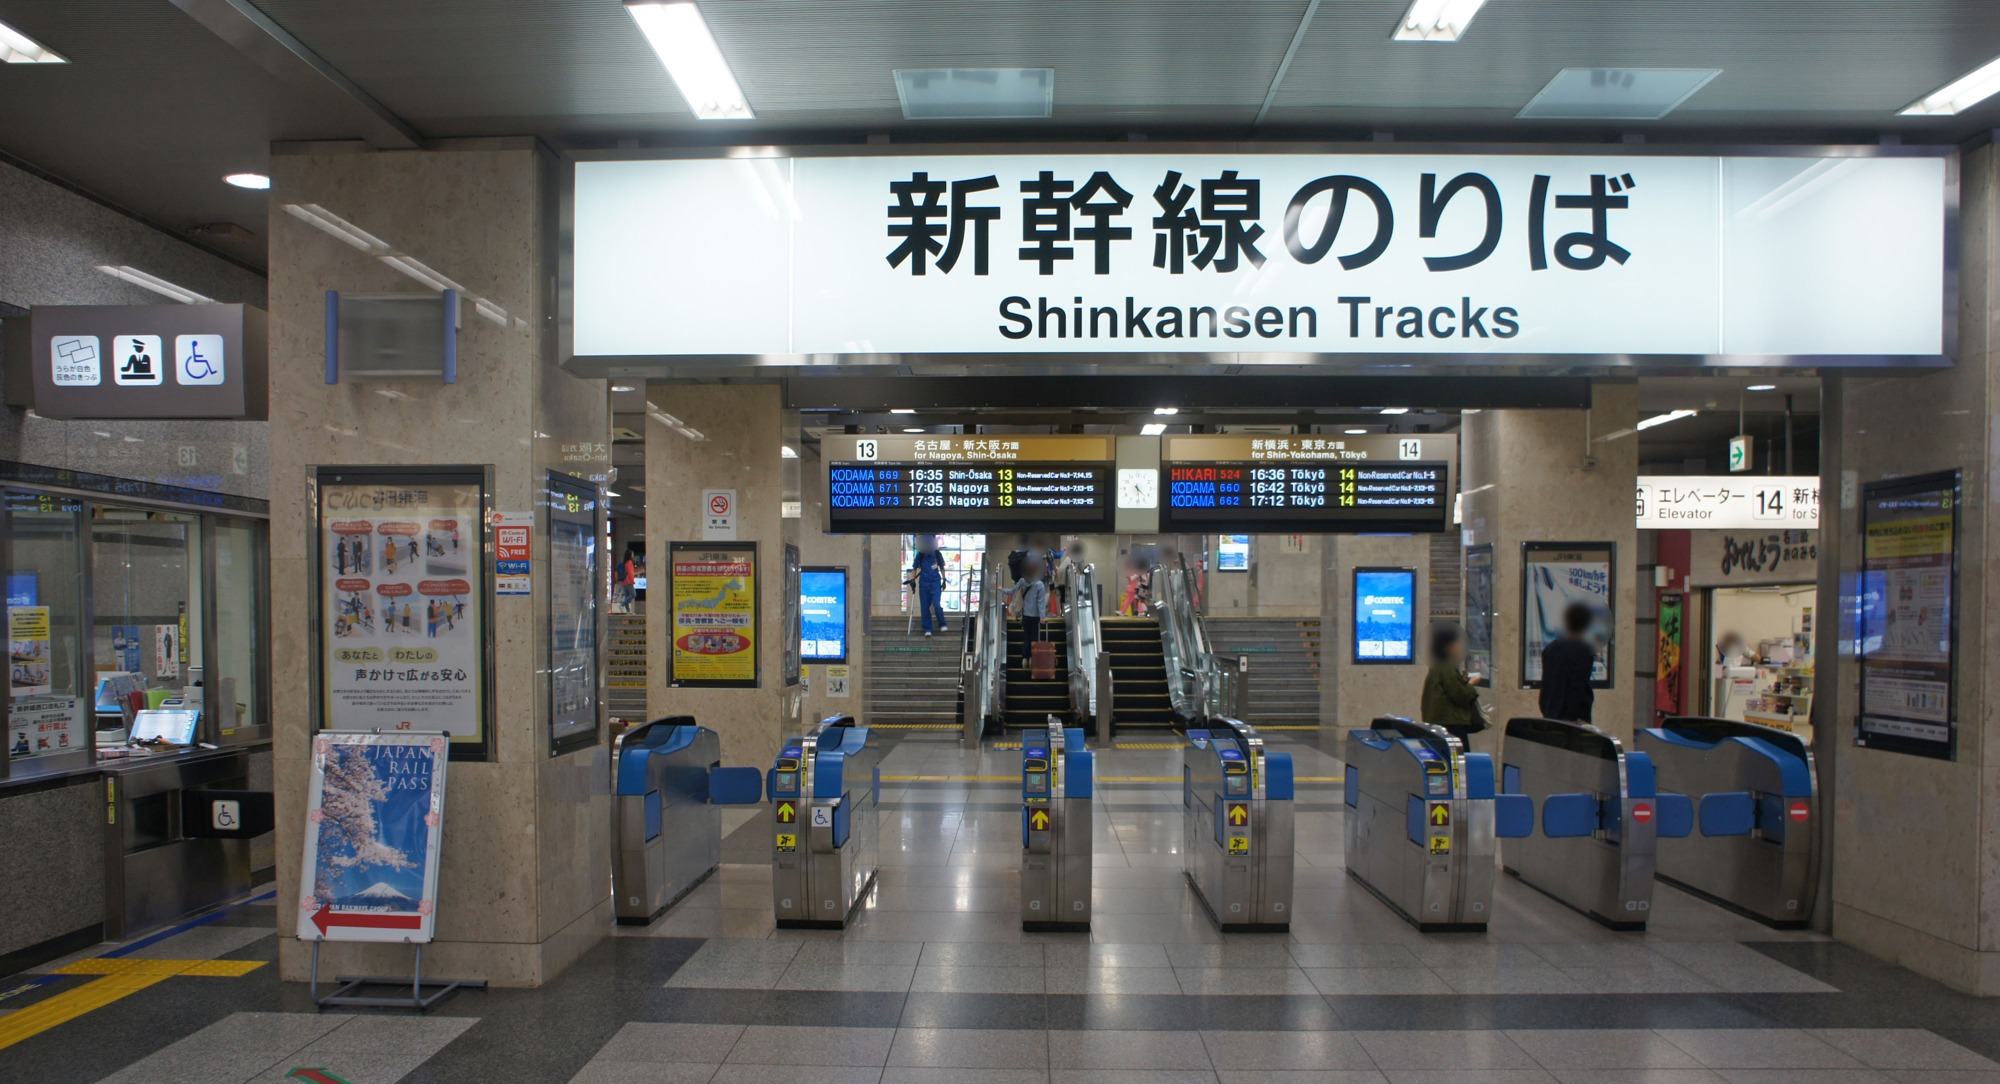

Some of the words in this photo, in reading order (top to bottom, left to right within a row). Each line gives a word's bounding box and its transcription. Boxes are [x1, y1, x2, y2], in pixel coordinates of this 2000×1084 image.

[886, 170, 1636, 276] 新幹線のりば
[998, 296, 1317, 339] Shinkansen
[1337, 296, 1520, 339] Tracks
[858, 442, 875, 458] 13
[914, 452, 927, 460] for
[929, 452, 964, 461] Nagoya,
[966, 450, 1017, 460] Shin-Ōsaka
[1252, 450, 1264, 458] for
[1266, 450, 1338, 460] Shin-Yokohama,
[1340, 450, 1367, 460] Tōkyō
[1402, 442, 1418, 458] 14
[832, 470, 874, 480] KODAMA
[880, 471, 898, 480] 669
[909, 470, 943, 480] 16:35
[948, 469, 992, 480] Shin-Ōsaka
[998, 470, 1013, 480] 13
[1172, 468, 1217, 480] HIKARI
[1220, 470, 1240, 480] 524
[1250, 469, 1285, 480] 16:36
[1290, 469, 1325, 482] Tōkyō
[1339, 469, 1354, 480] 14
[1401, 471, 1412, 479] Car
[832, 482, 874, 494] KODAMA
[880, 484, 898, 492] 671
[909, 482, 943, 494] 17:05
[948, 483, 990, 494] Nagoya
[998, 482, 1013, 494] 13
[1172, 482, 1216, 494] KODAMA
[1220, 484, 1240, 492] 660
[1250, 482, 1284, 494] 16:42
[1290, 482, 1325, 494] Tōkyō
[1339, 482, 1354, 494] 14
[832, 496, 875, 506] KODAMA
[880, 497, 900, 506] 673
[909, 496, 944, 506] 17:35
[948, 496, 990, 507] Nagoya
[998, 496, 1013, 506] 13
[1172, 495, 1216, 506] KODAMA
[1220, 496, 1240, 506] 662
[1250, 495, 1284, 506] 17:12
[1290, 495, 1324, 507] Tōkyō
[1338, 495, 1354, 506] 14
[1659, 488, 1745, 504] エレベーター
[1756, 490, 1783, 515] 14
[1659, 508, 1712, 519] Elevator
[1792, 508, 1808, 519] for
[342, 650, 378, 660] あなたと
[395, 650, 432, 660] わたしの
[355, 668, 466, 681] 声かけで広がる安心
[396, 722, 410, 730] JR
[374, 746, 430, 760] JAPAN
[390, 761, 429, 774] RAIL
[388, 776, 428, 790] PASS
